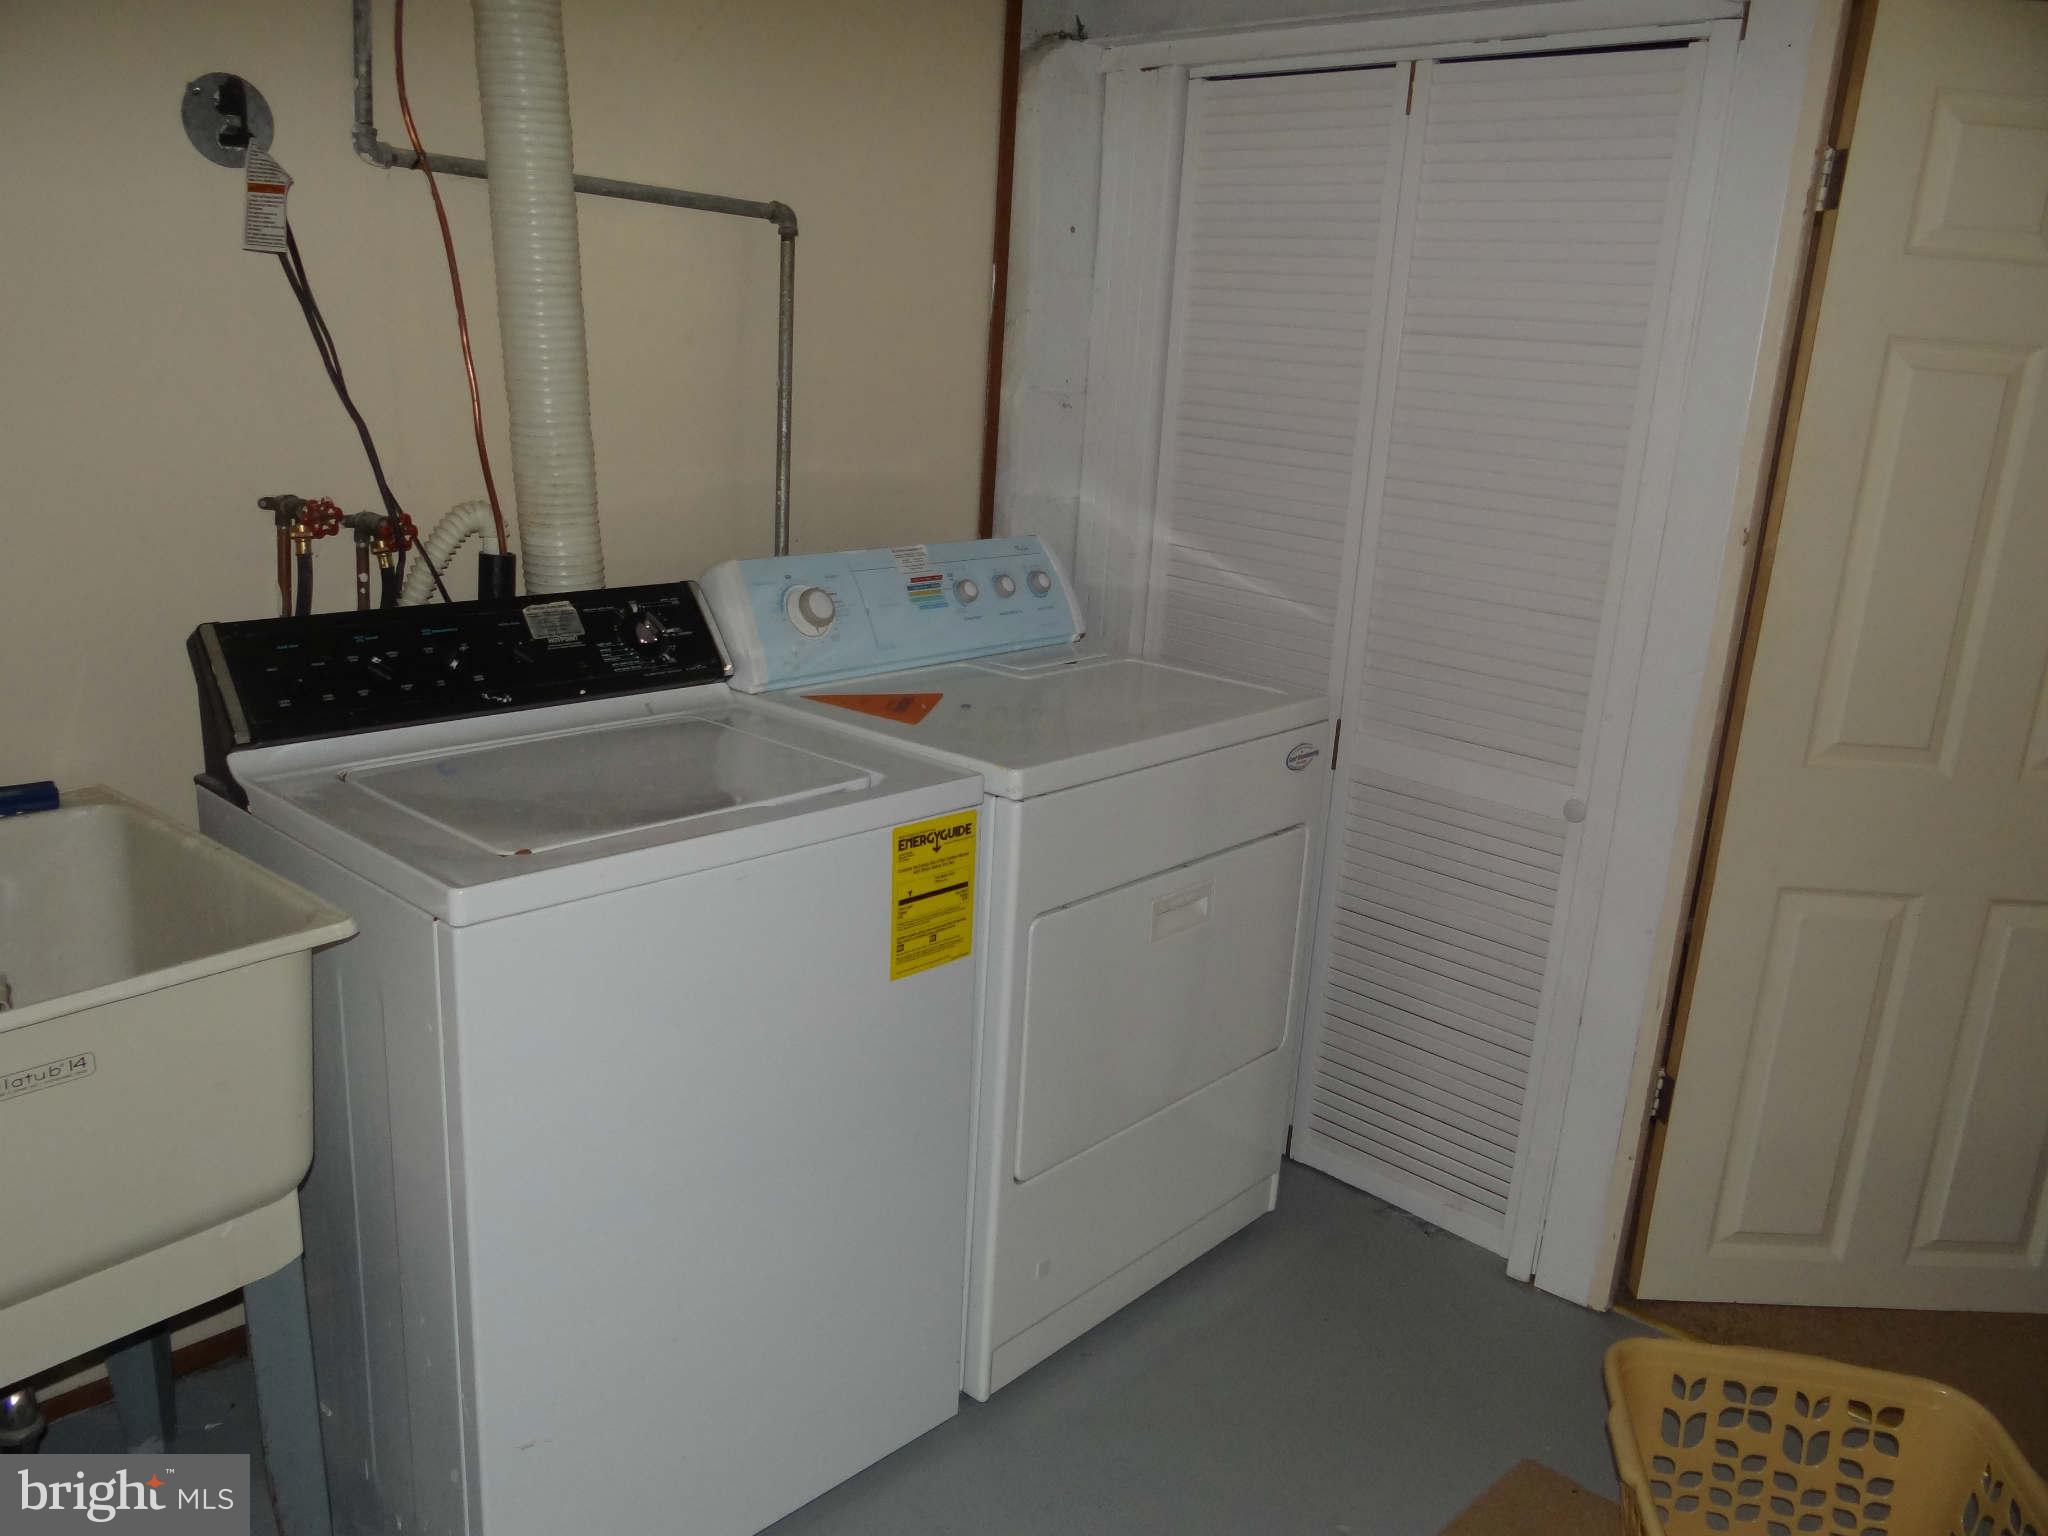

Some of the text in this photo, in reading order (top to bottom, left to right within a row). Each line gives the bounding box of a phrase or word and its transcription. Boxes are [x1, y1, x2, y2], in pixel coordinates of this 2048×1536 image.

[898, 823, 972, 851] ENERGYGUIDE
[0, 1065, 62, 1090] latub
[69, 1056, 87, 1072] 14
